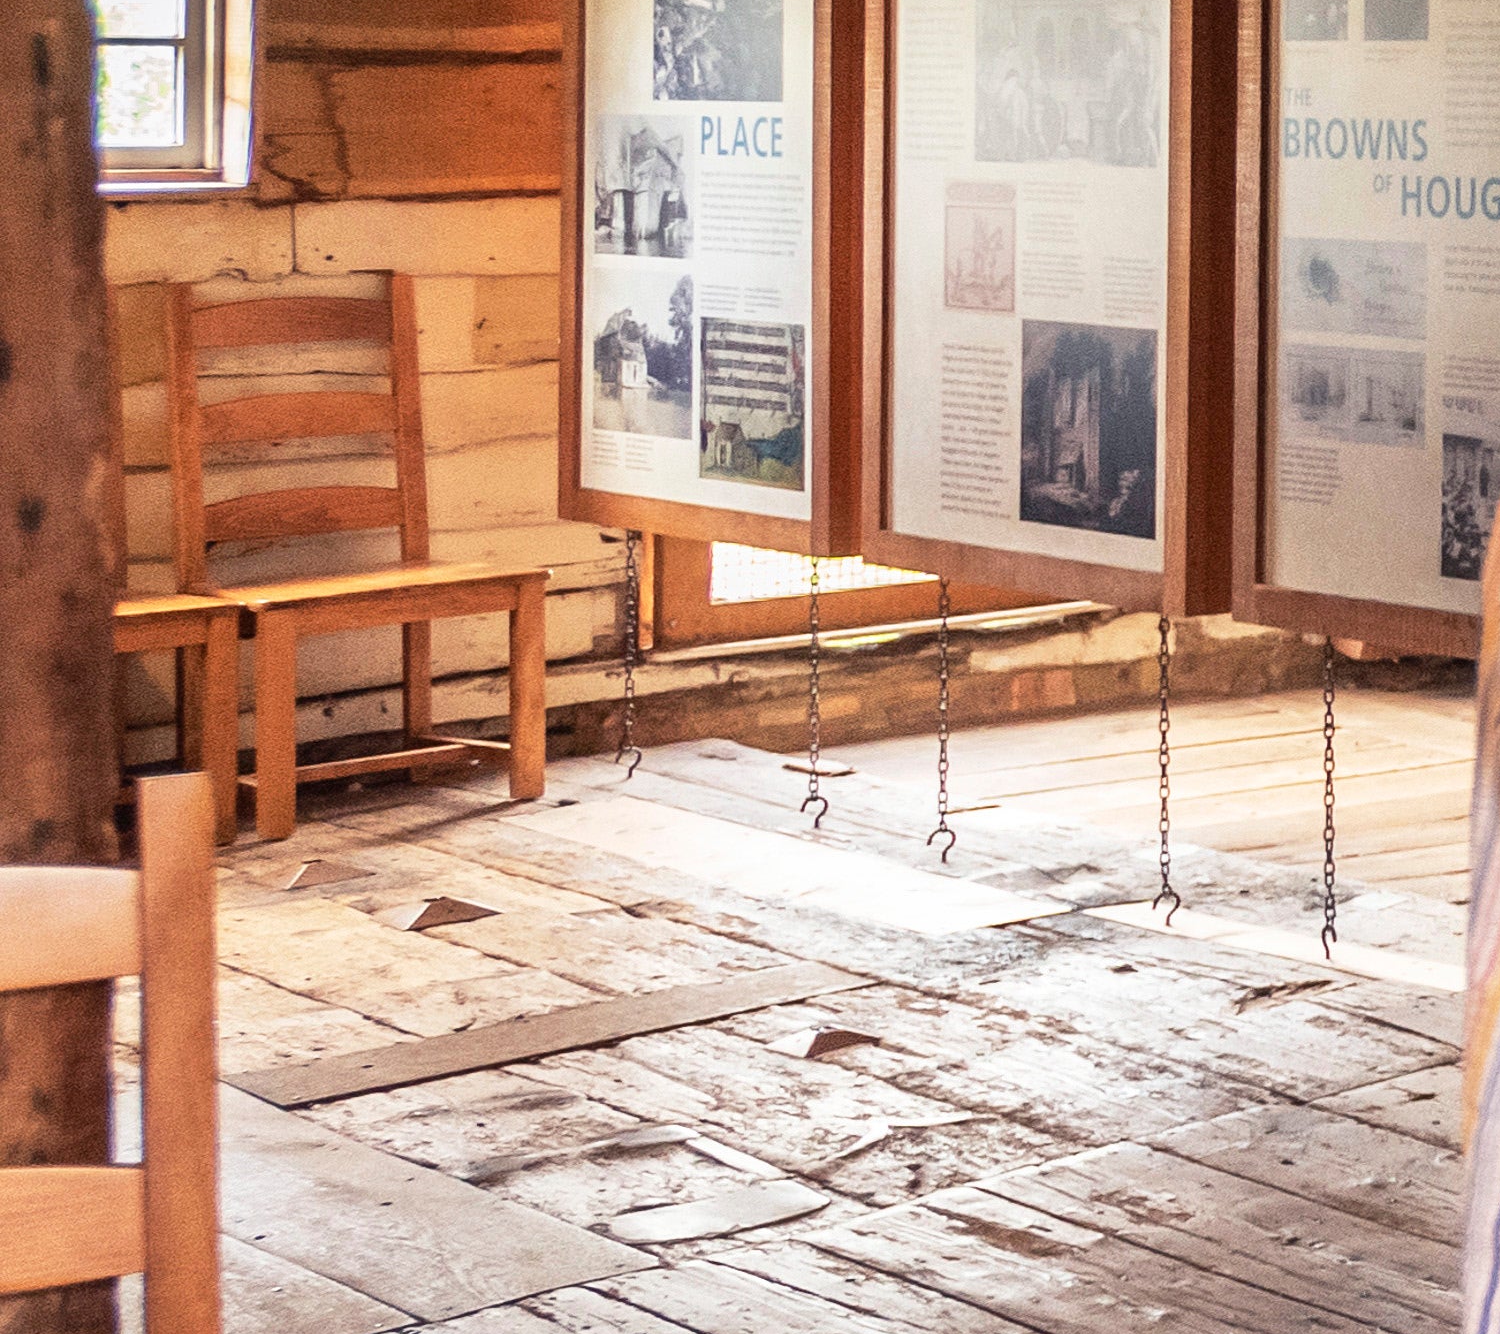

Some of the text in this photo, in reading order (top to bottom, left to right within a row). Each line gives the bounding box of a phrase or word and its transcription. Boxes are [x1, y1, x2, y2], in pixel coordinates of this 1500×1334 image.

[1284, 88, 1312, 107] THE
[700, 115, 784, 158] PLACE
[1283, 117, 1429, 162] BROWNS
[1372, 173, 1393, 194] OF
